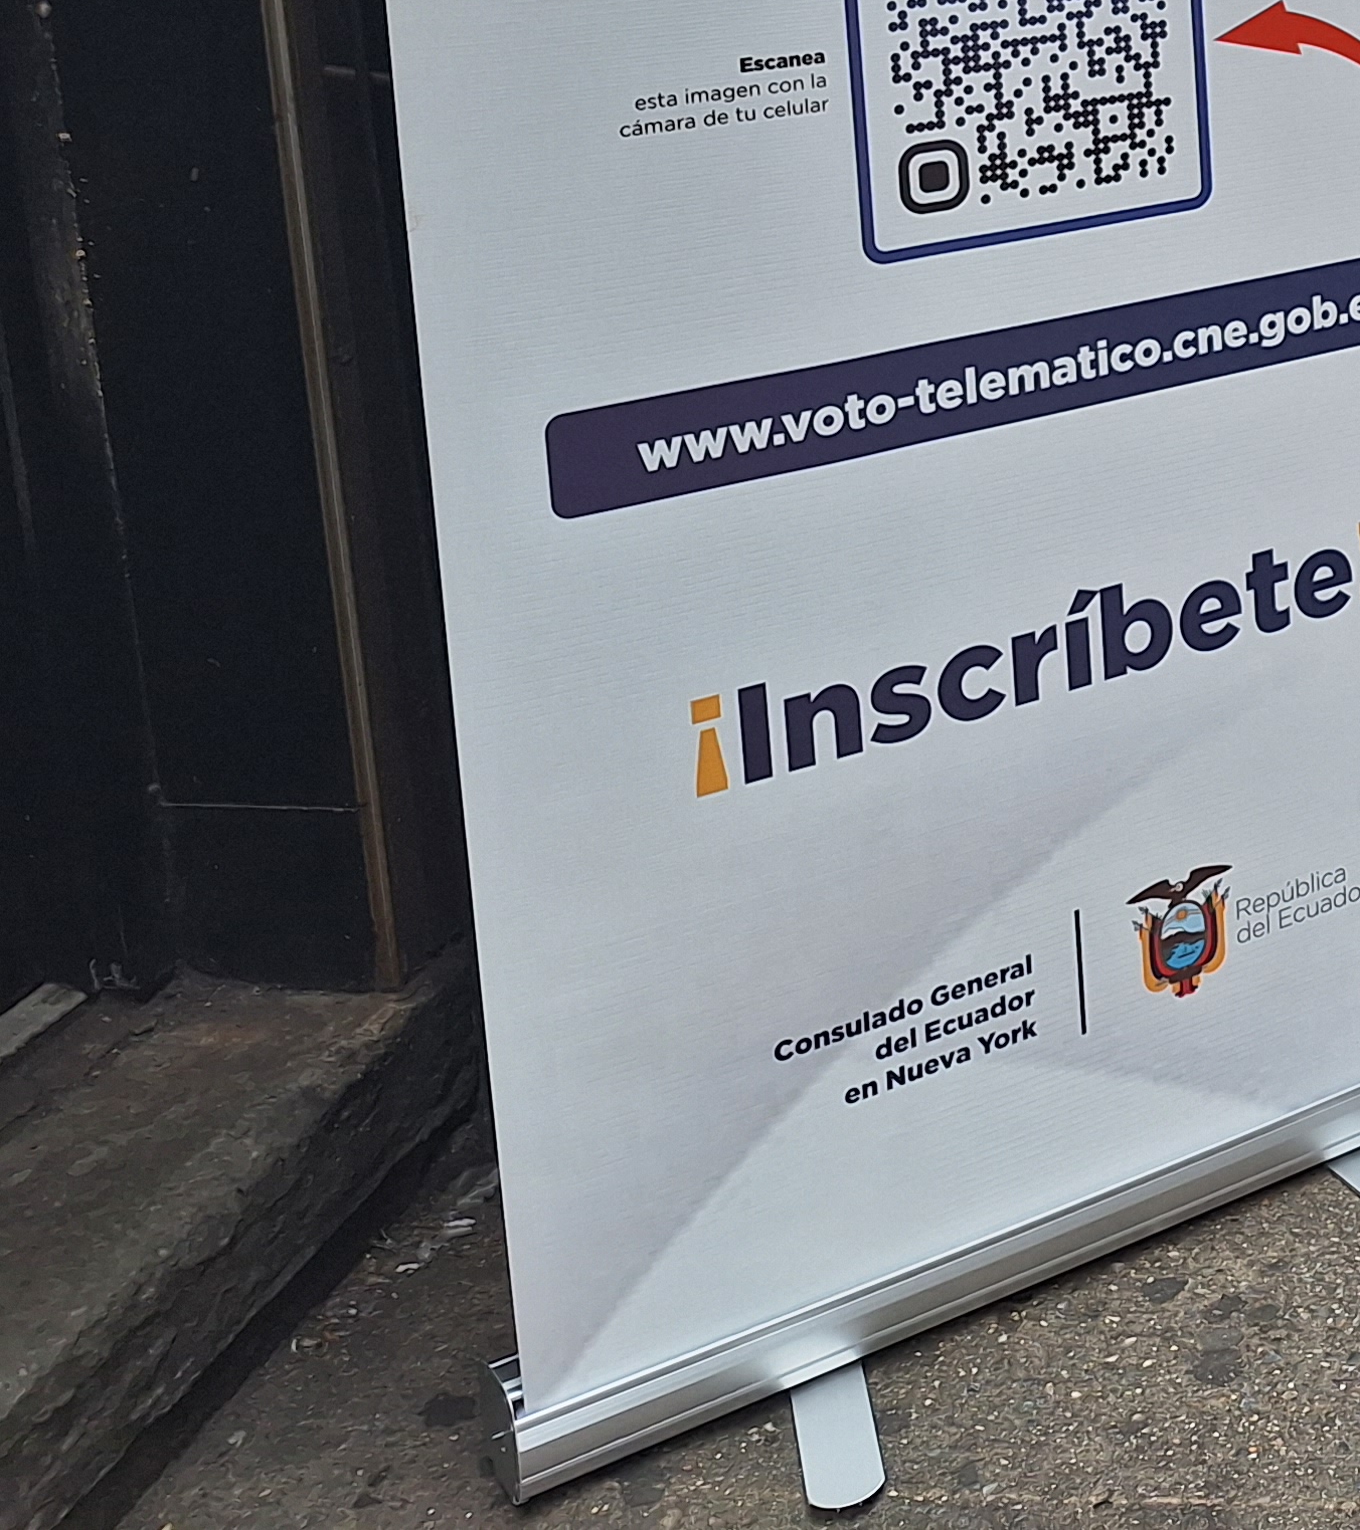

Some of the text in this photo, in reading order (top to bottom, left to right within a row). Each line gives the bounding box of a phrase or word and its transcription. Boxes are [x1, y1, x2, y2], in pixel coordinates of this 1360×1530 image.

[739, 52, 825, 73] Escanea
[635, 73, 827, 110] esta imagen con la
[619, 98, 829, 137] cámara de tu celular
[1235, 866, 1348, 921] República
[1235, 914, 1272, 944] del
[773, 954, 1034, 1063] Consulado General
[874, 987, 1036, 1062] del Ecuador
[843, 1016, 1039, 1106] en Nueva York
